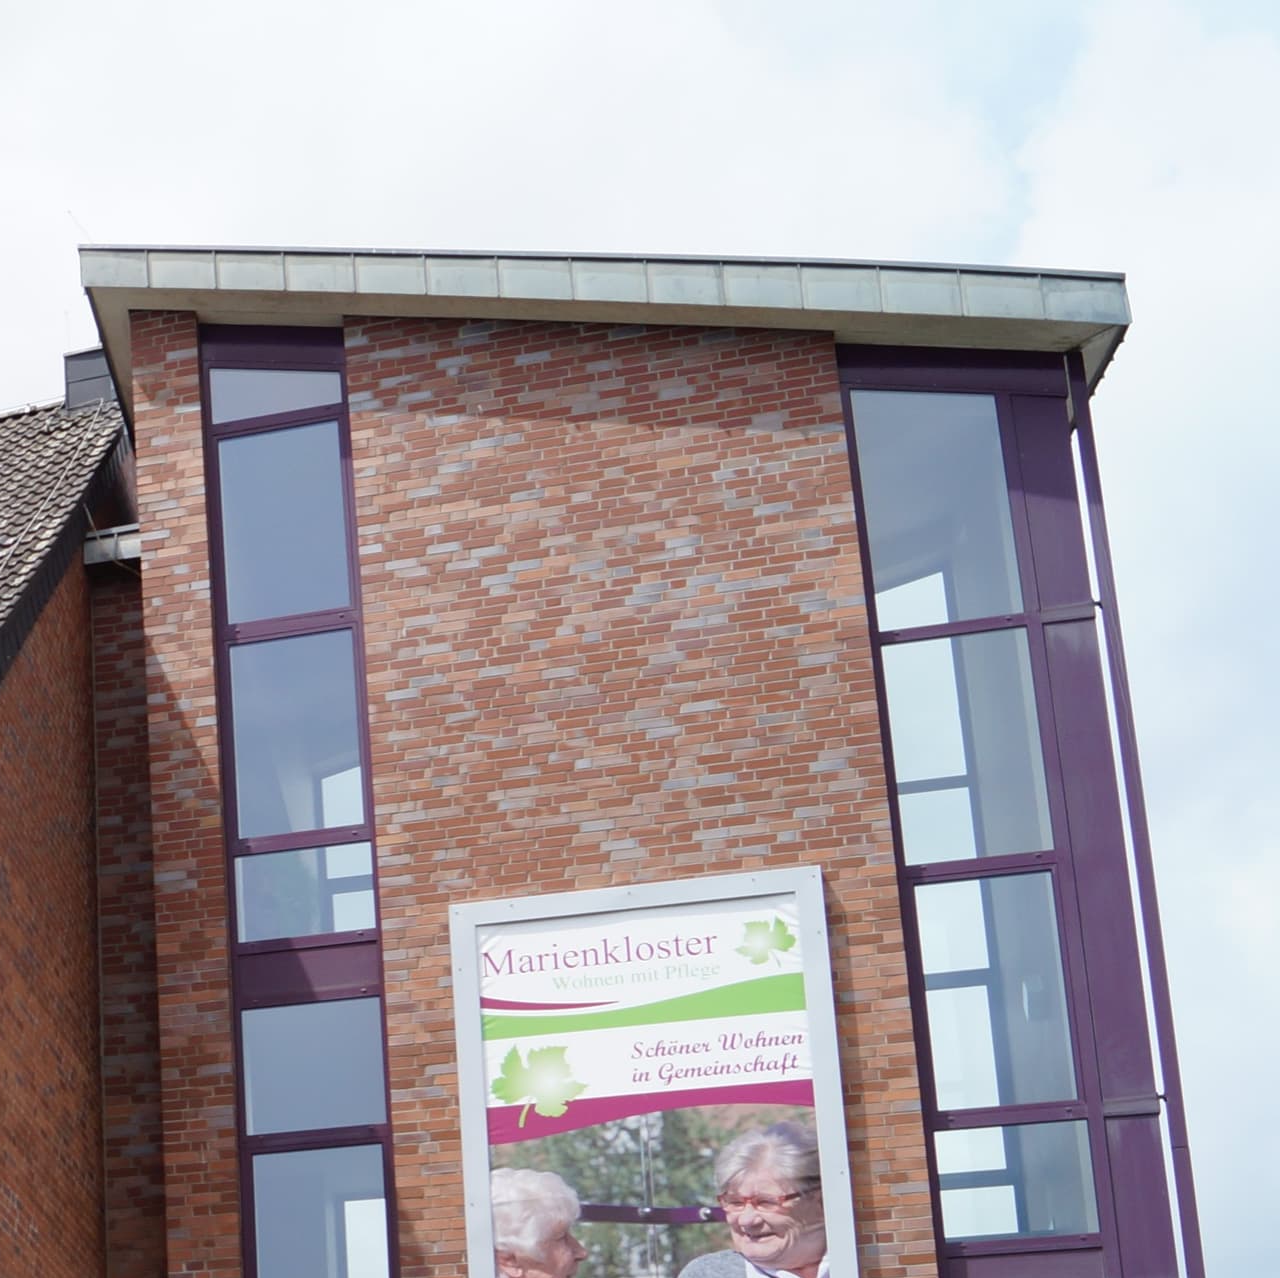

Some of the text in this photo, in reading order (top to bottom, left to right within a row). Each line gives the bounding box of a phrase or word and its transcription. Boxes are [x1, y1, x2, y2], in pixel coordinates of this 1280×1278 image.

[481, 935, 718, 978] Marienkloster
[551, 962, 721, 992] Wohnen mit Pflege
[630, 1030, 805, 1060] Schöner Wohnen
[631, 1052, 801, 1086] in Gemeinschaft
